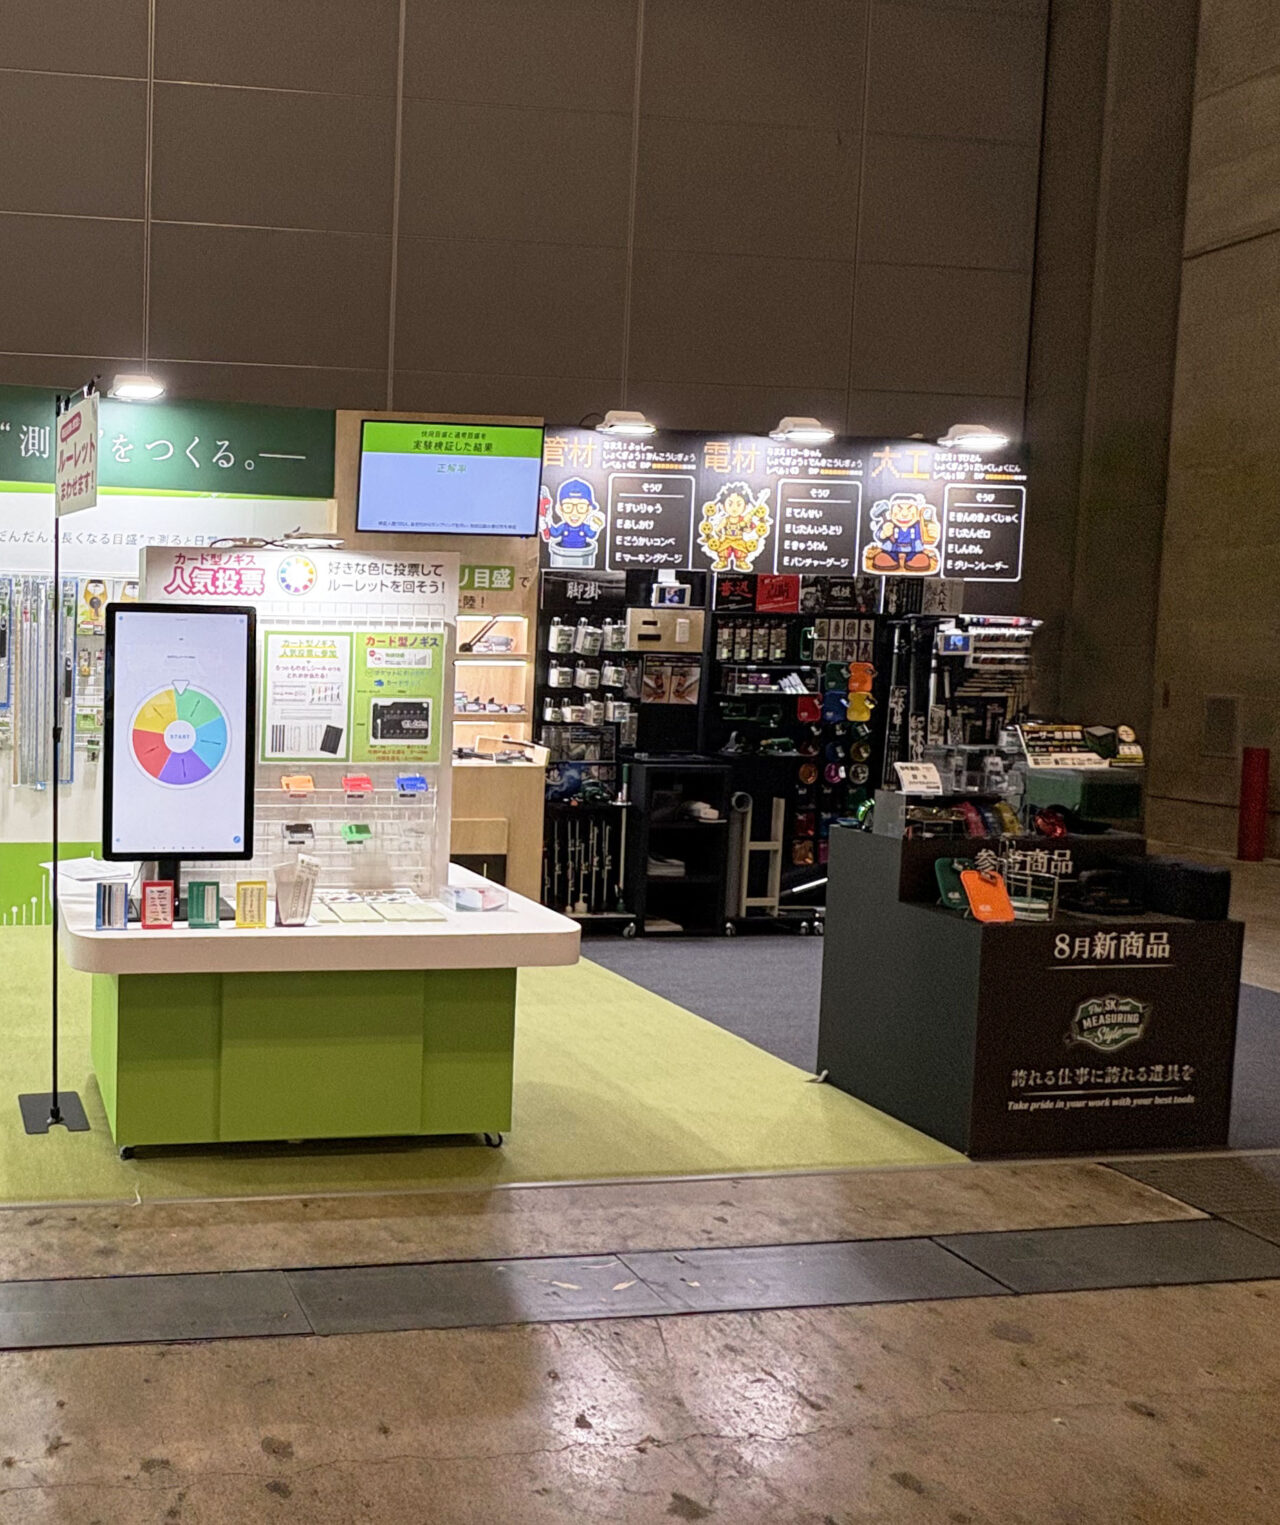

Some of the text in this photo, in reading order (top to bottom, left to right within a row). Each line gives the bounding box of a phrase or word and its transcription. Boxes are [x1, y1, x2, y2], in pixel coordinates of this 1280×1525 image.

[58, 432, 96, 473] ルーレット
[413, 440, 493, 452] 実験検証した結果
[544, 436, 597, 468] 管材
[704, 441, 761, 474] 電材
[872, 446, 930, 480] 大工
[174, 553, 256, 566] カード型ノギス
[328, 561, 444, 577] 好きな色に投票して
[164, 567, 265, 596] 人気投票
[328, 580, 445, 594] ルーレットを回そう！
[282, 639, 337, 648] カード型ノギス
[365, 636, 439, 647] カード型ノギス
[1053, 931, 1170, 959] 8月新商品
[1083, 1013, 1140, 1030] MEASURING
[1011, 1064, 1195, 1087] 誇れる仕事に誇れる道具を
[1008, 1094, 1195, 1111] Take pride in your work with your best tools
